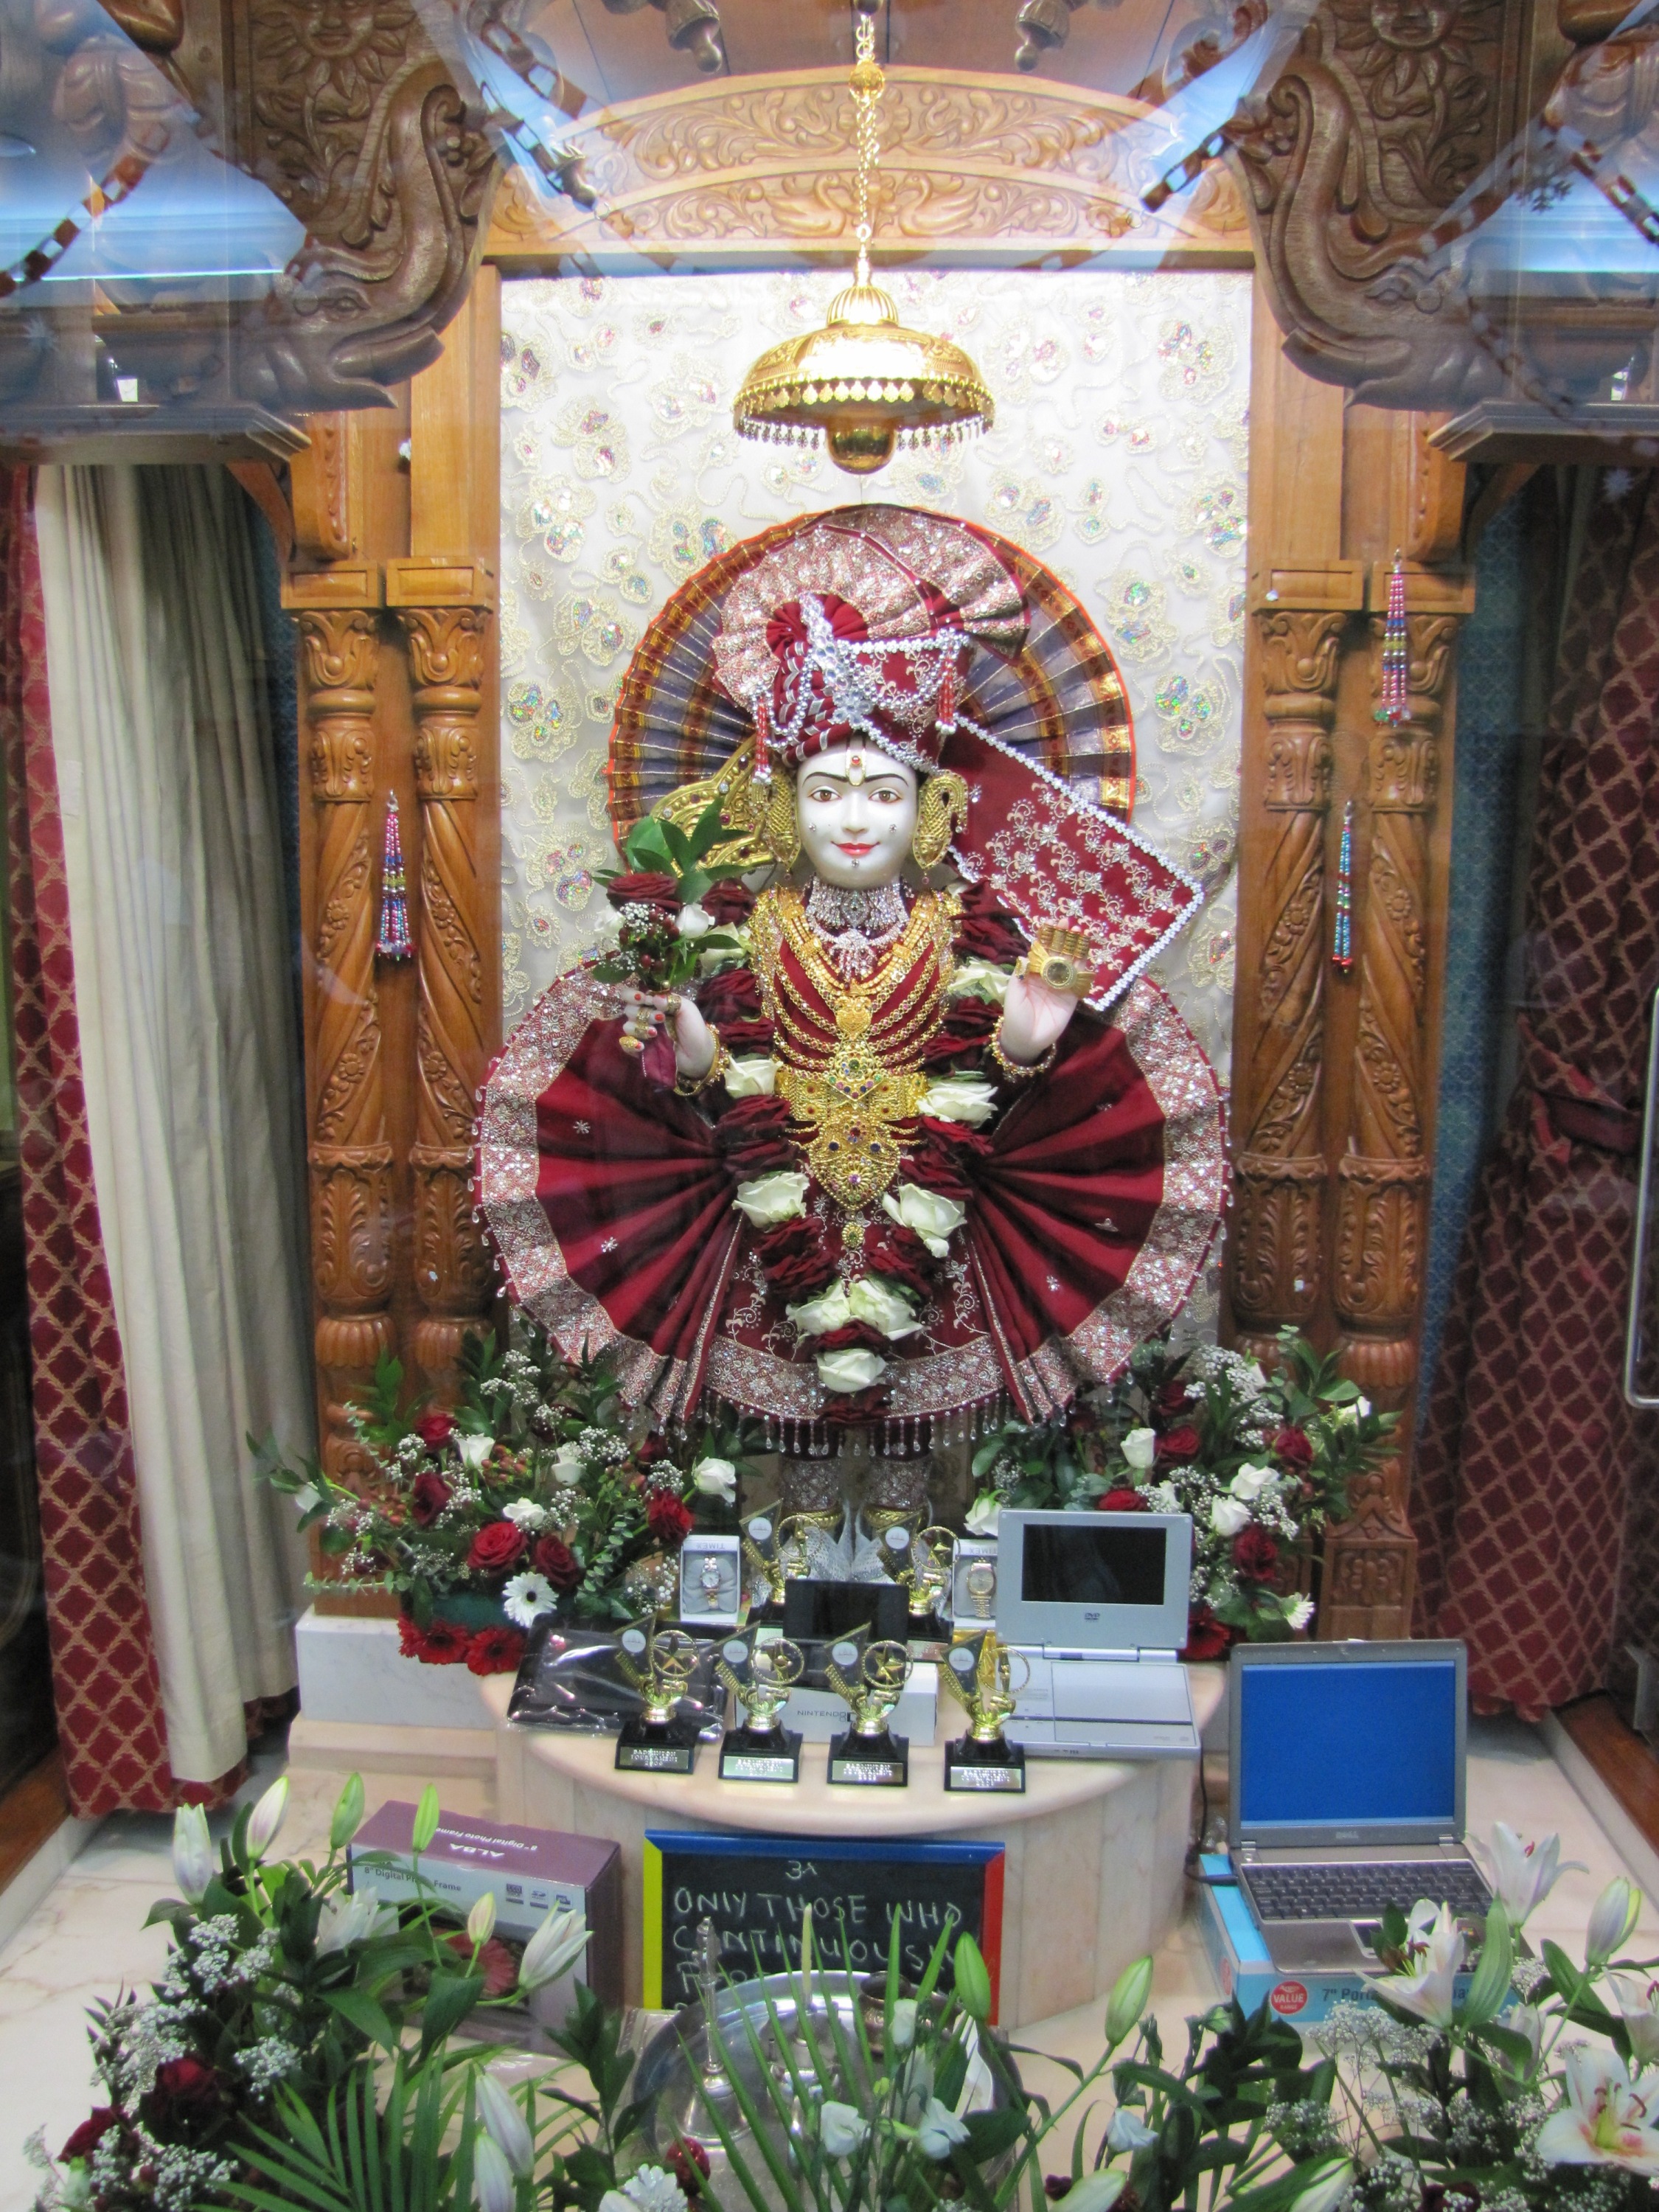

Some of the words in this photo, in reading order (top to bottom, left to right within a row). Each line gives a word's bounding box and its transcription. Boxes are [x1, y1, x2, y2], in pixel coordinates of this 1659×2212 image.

[436, 1827, 464, 1837] Frame
[465, 1832, 493, 1843] Photo
[450, 1843, 504, 1857] ALBA
[492, 1839, 524, 1849] Digital
[375, 1868, 404, 1880] Digital
[434, 1879, 462, 1891] Frame
[757, 1892, 866, 1924] THOSE
[674, 1924, 955, 1972] CNTINUOUS
[1273, 1993, 1304, 2003] VALUE
